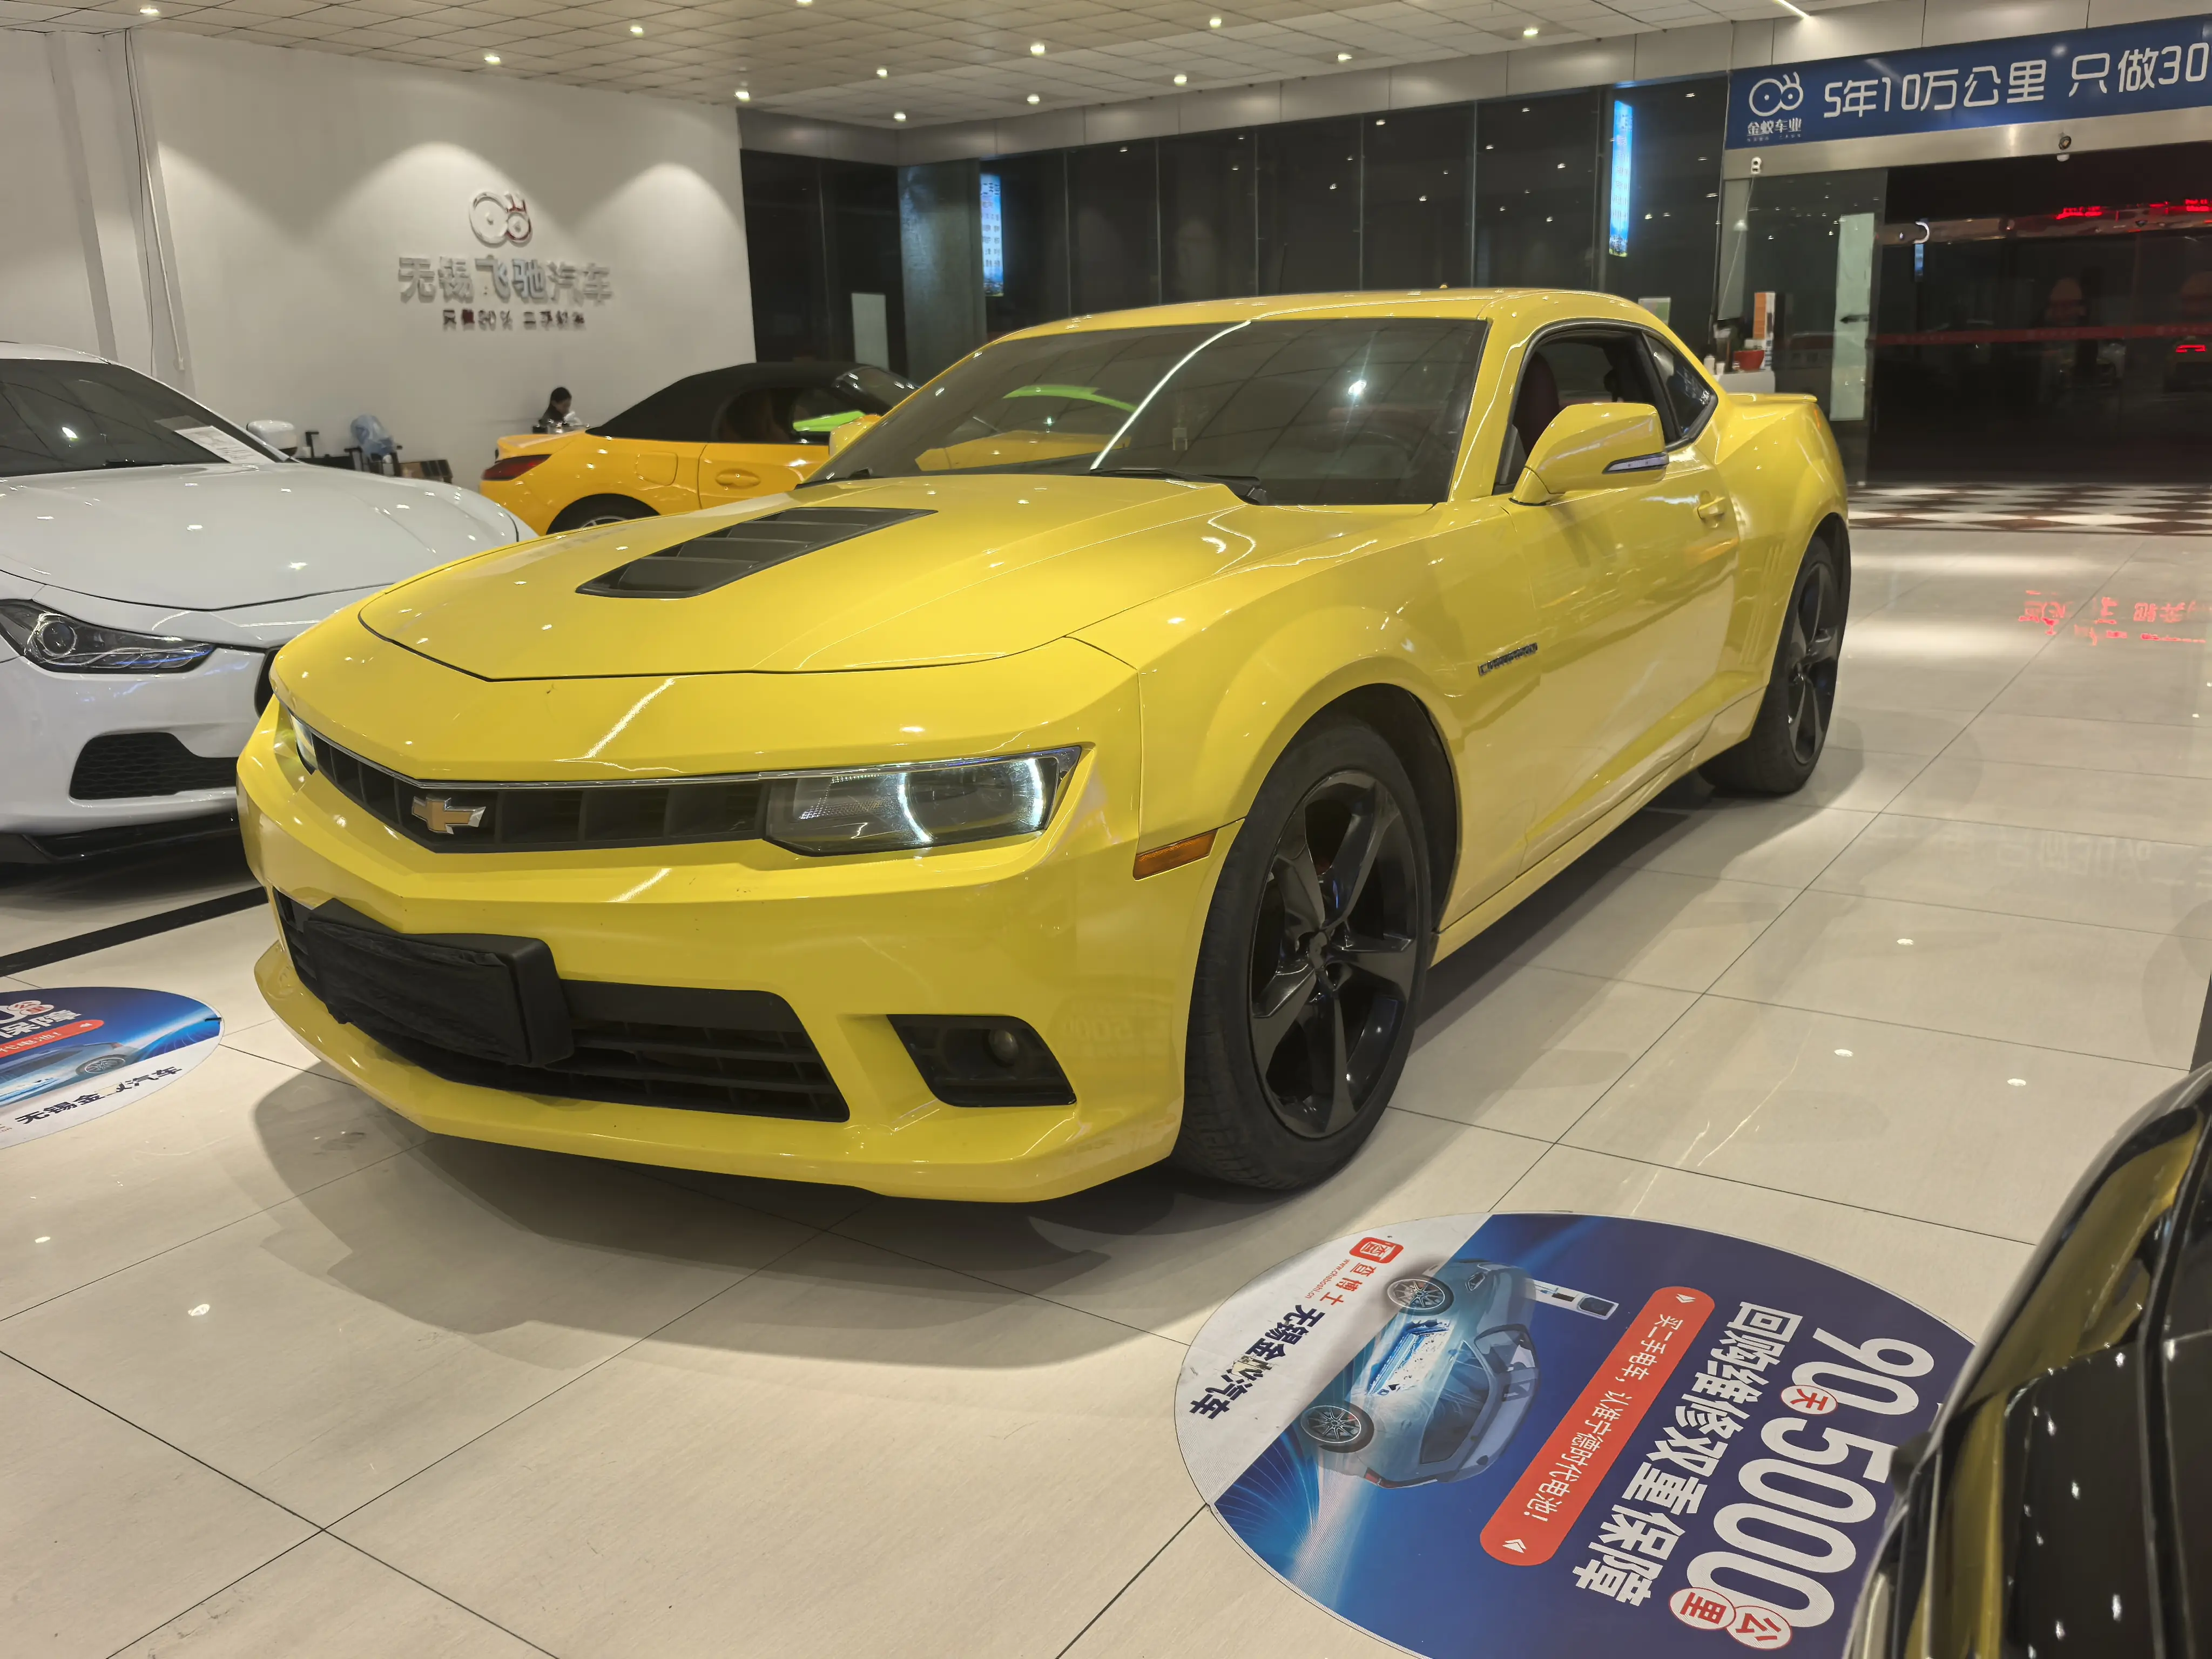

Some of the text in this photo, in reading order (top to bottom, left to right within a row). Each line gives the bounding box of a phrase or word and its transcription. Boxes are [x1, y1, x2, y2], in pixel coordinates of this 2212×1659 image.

[1823, 42, 2210, 118] 5年10万公里 只做30
[1747, 117, 1802, 136] 金蚁车业
[398, 255, 613, 304] 无锡飞驰汽车
[1305, 1259, 1351, 1299] www.chaboshi.cn
[1319, 1262, 1377, 1305] 查博士
[1571, 1301, 1804, 1607] 回购维修双重保障
